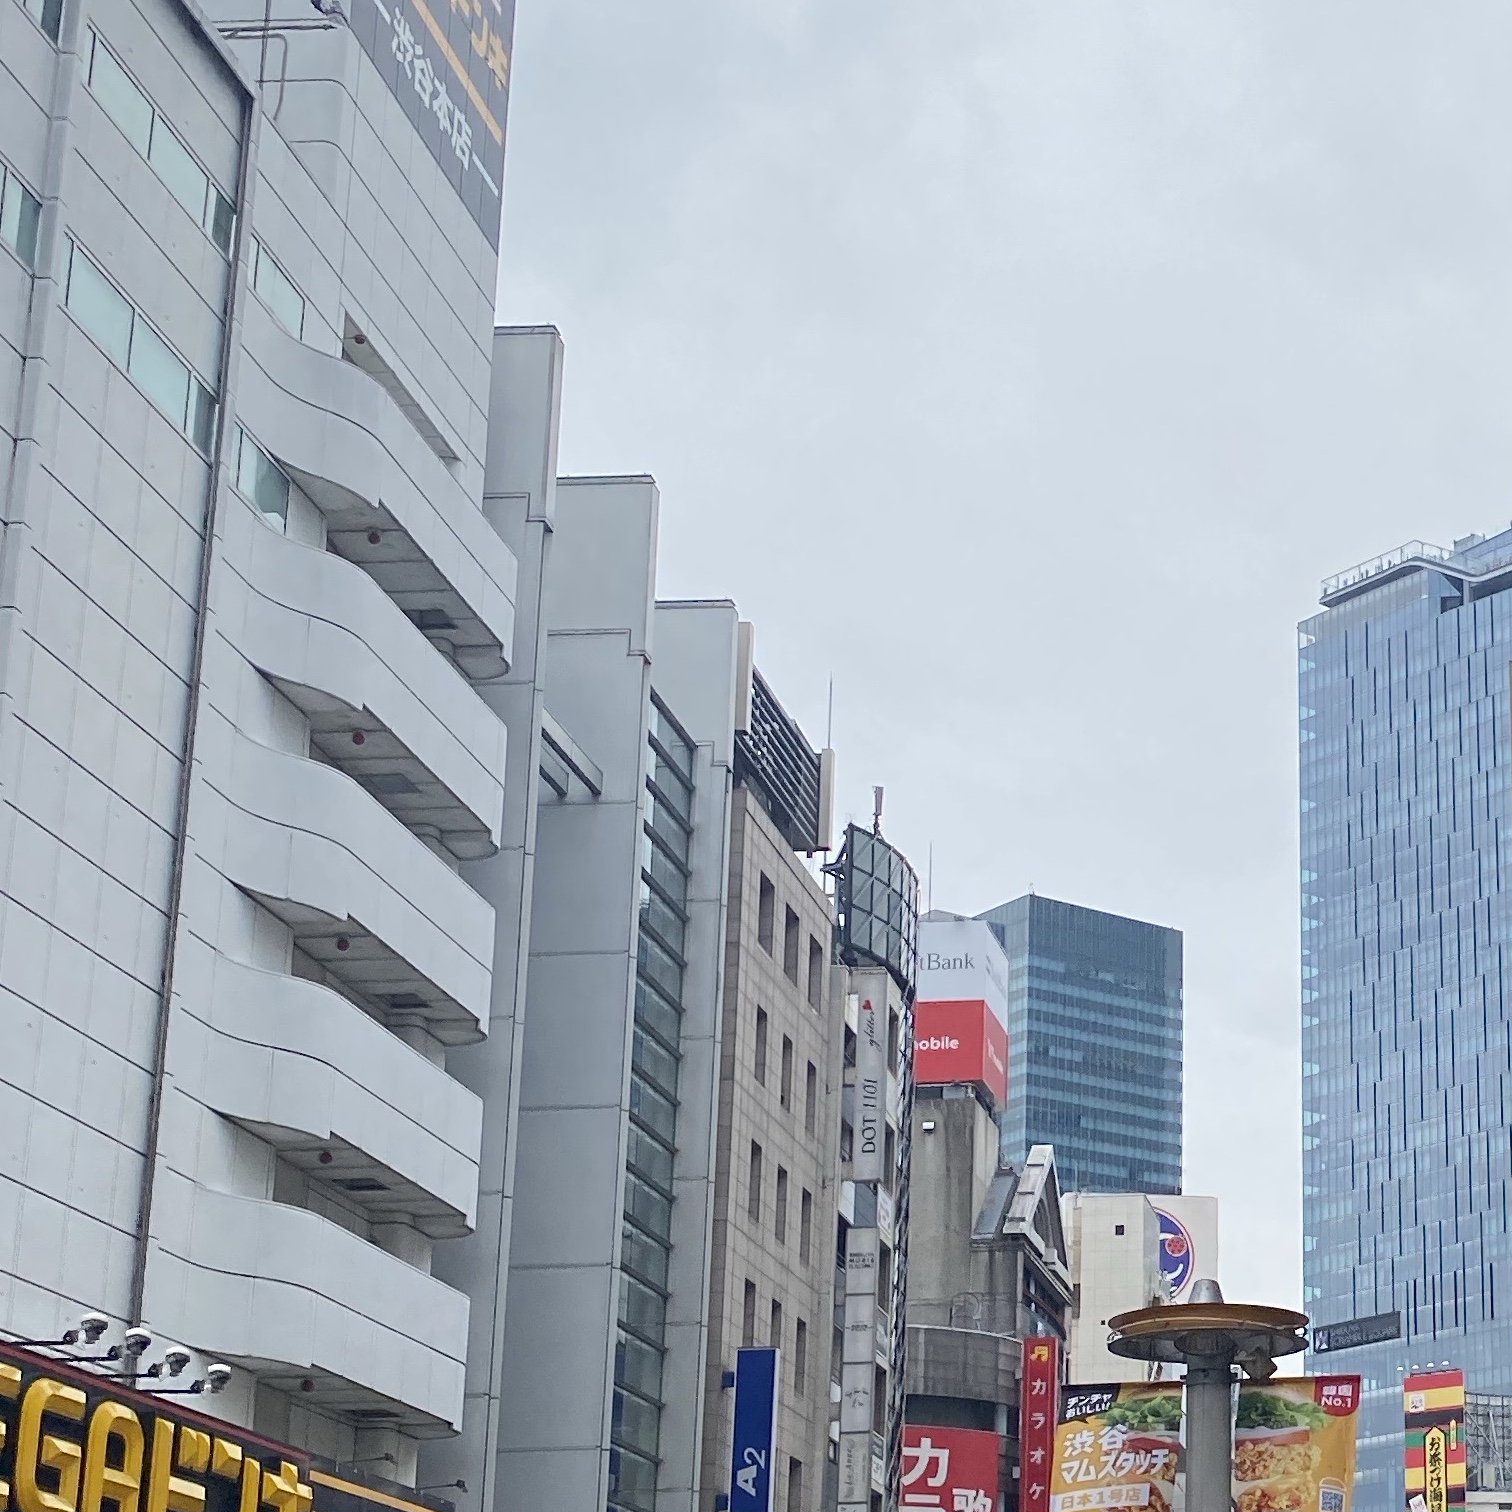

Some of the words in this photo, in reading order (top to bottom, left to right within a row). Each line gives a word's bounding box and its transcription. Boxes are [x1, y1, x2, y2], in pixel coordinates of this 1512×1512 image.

[391, 6, 473, 171] 渋谷本店
[1320, 1396, 1352, 1408] No.1
[1063, 1424, 1129, 1459] 渋谷
